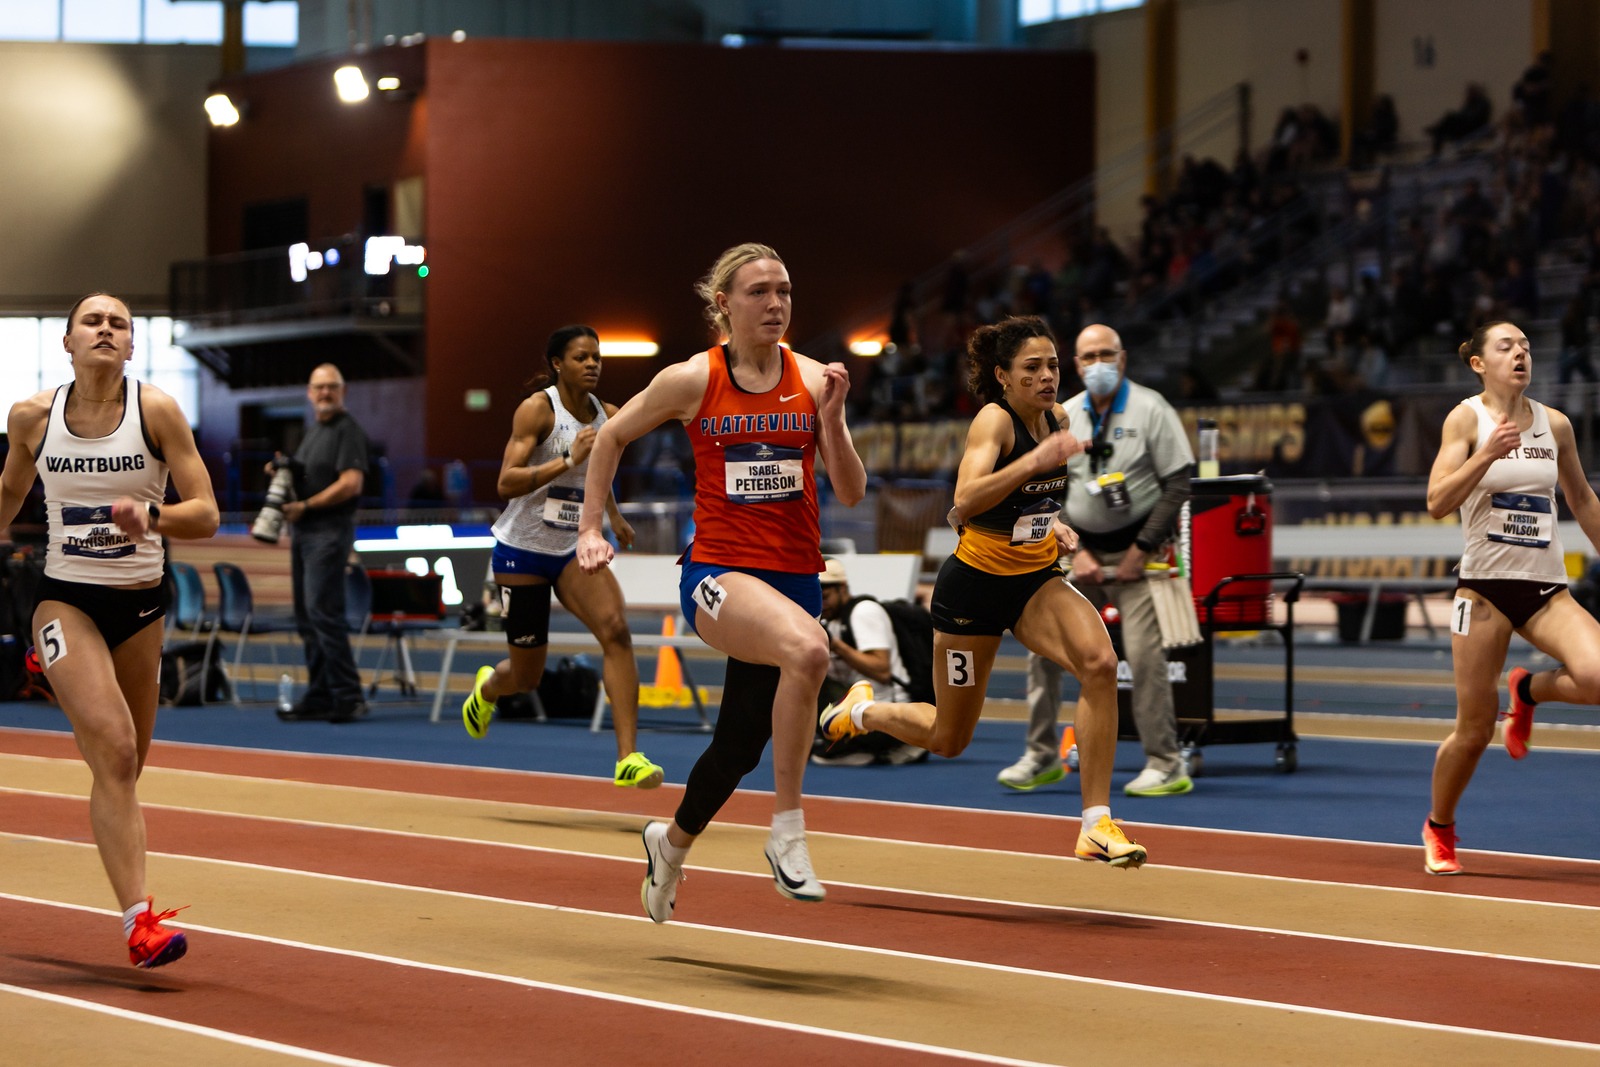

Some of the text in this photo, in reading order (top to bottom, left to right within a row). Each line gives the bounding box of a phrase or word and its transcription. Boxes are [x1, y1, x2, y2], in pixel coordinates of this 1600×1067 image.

[701, 412, 815, 436] PLATTEVILLE
[1523, 447, 1555, 461] SOUND
[46, 454, 145, 473] WARTBURG
[749, 464, 782, 476] ISABEL
[735, 475, 796, 491] PETERSON
[1024, 479, 1067, 492] CENTRE
[557, 510, 580, 522] HAYES
[1507, 513, 1538, 524] KYRSTIN
[88, 526, 110, 537] JOJO
[1503, 523, 1540, 537] WILSON
[67, 535, 131, 548] TYYNISMAA
[700, 581, 722, 610] 4
[1457, 601, 1466, 632] 1
[42, 623, 60, 663] 5
[952, 652, 969, 685] 3
